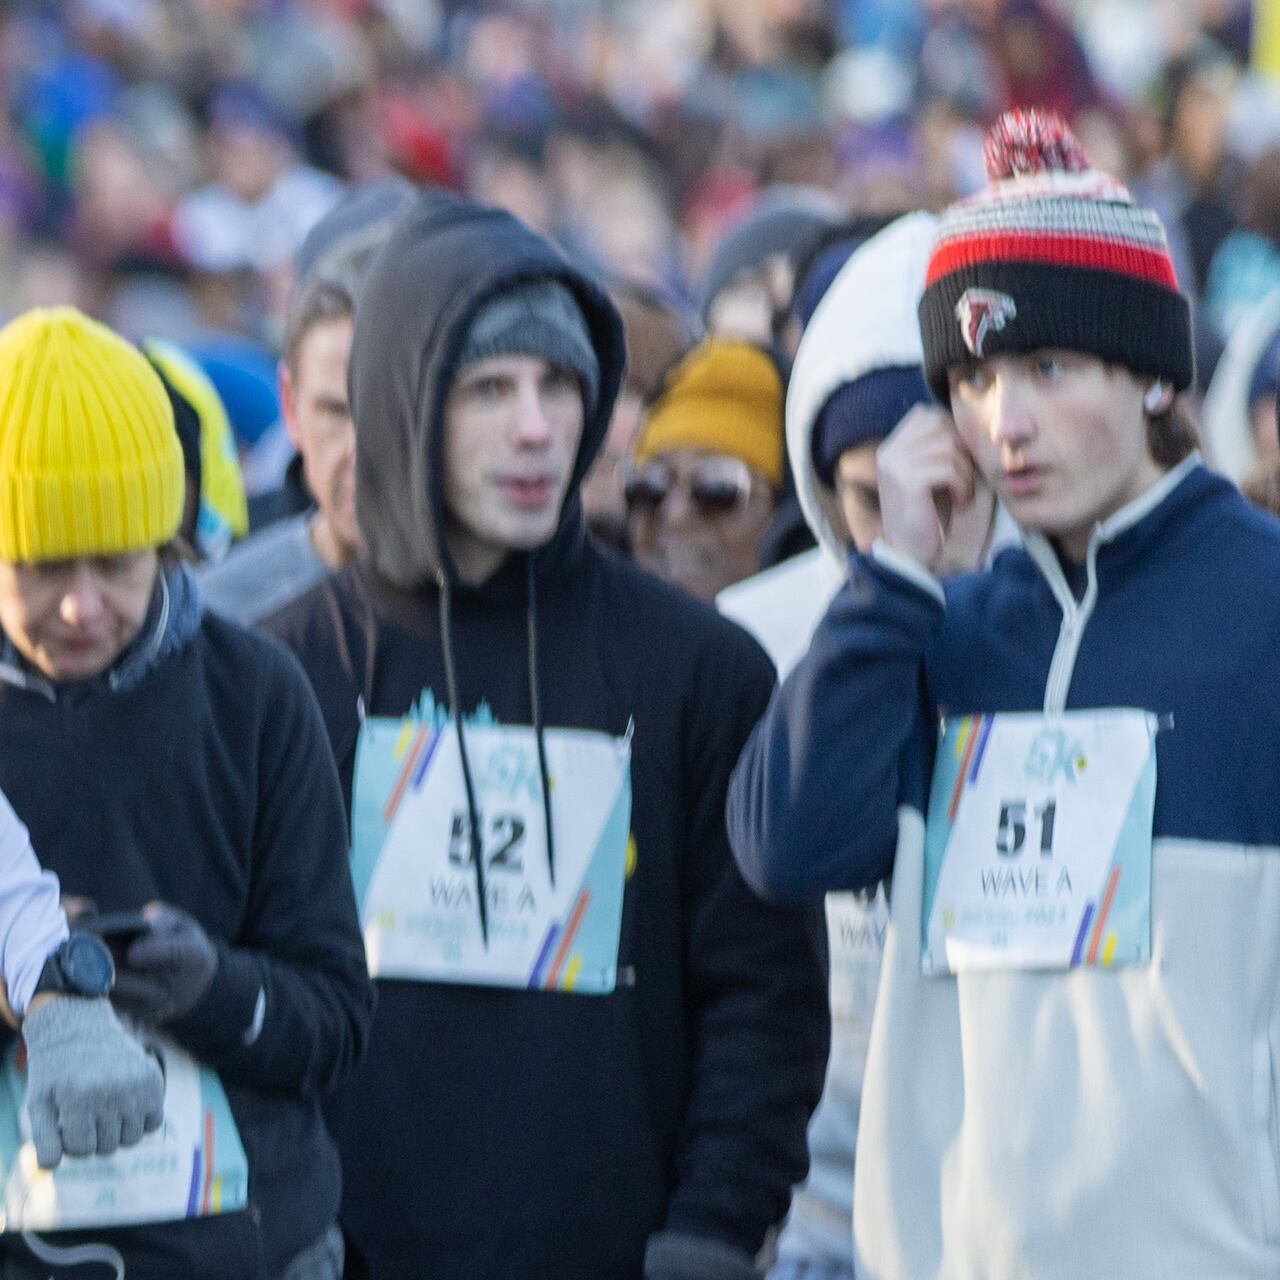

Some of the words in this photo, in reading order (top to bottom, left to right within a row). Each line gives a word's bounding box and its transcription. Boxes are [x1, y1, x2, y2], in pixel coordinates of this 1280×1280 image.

[448, 810, 526, 873] 52
[995, 798, 1057, 857] 51
[980, 868, 1043, 898] WAVE
[1056, 866, 1073, 897] A
